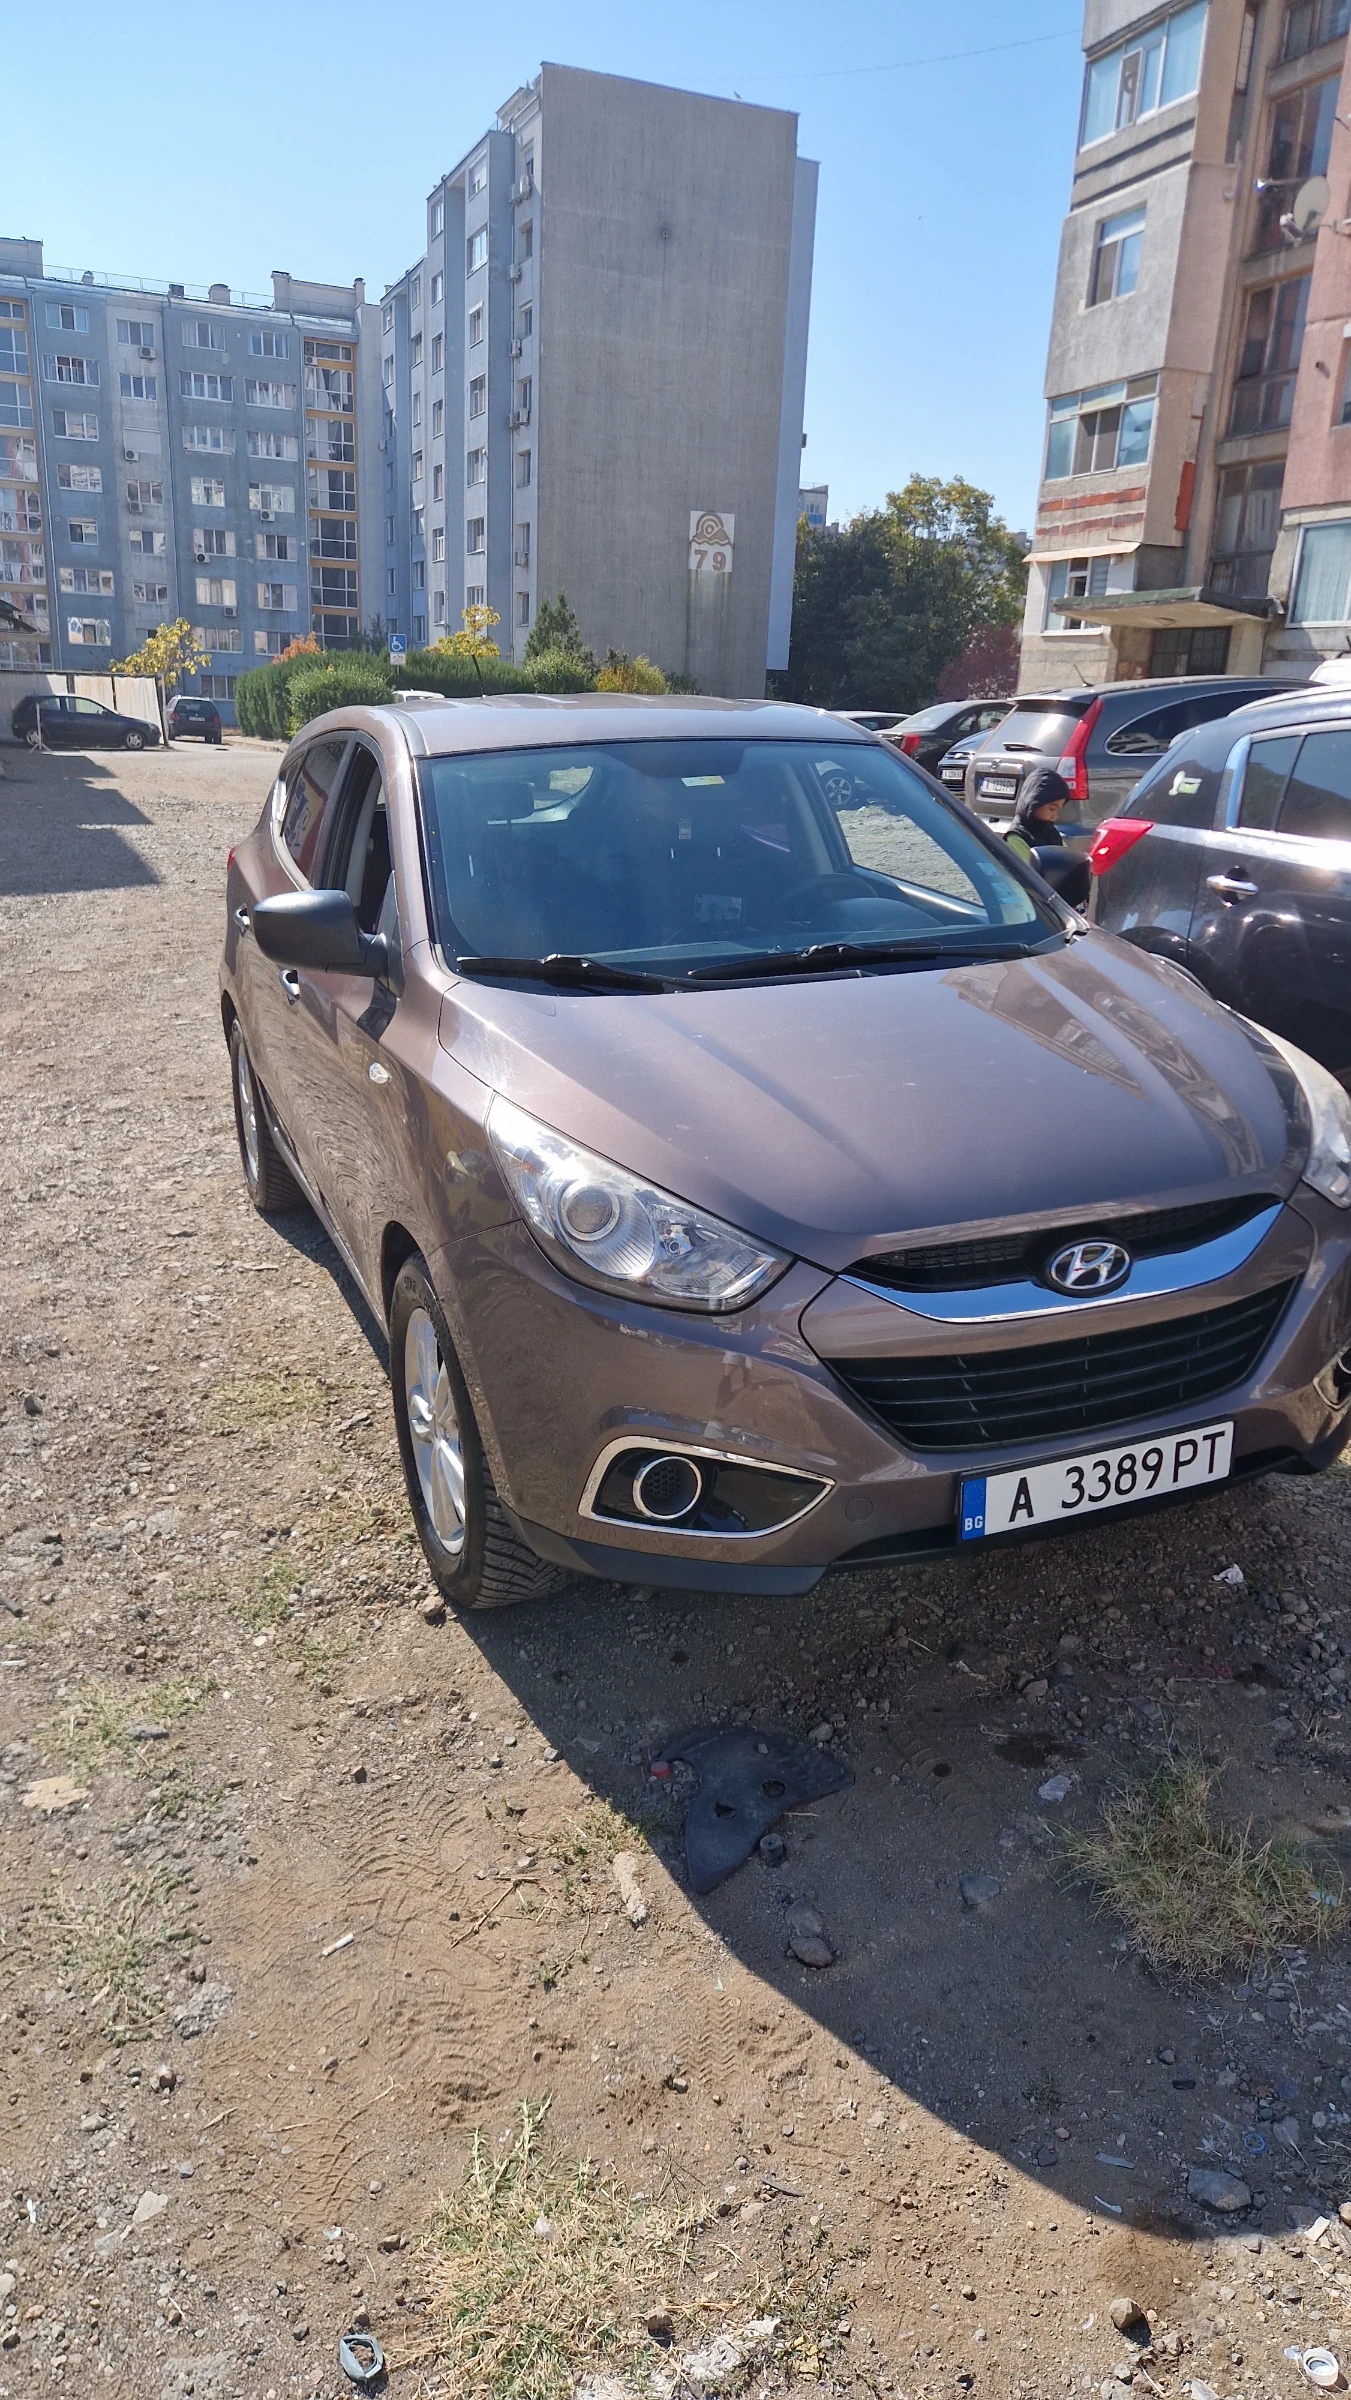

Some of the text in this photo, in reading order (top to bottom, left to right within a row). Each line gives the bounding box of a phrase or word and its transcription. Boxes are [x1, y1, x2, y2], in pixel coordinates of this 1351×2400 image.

[694, 549, 727, 571] 79
[1008, 1477, 1034, 1523] A
[964, 1515, 984, 1532] BG
